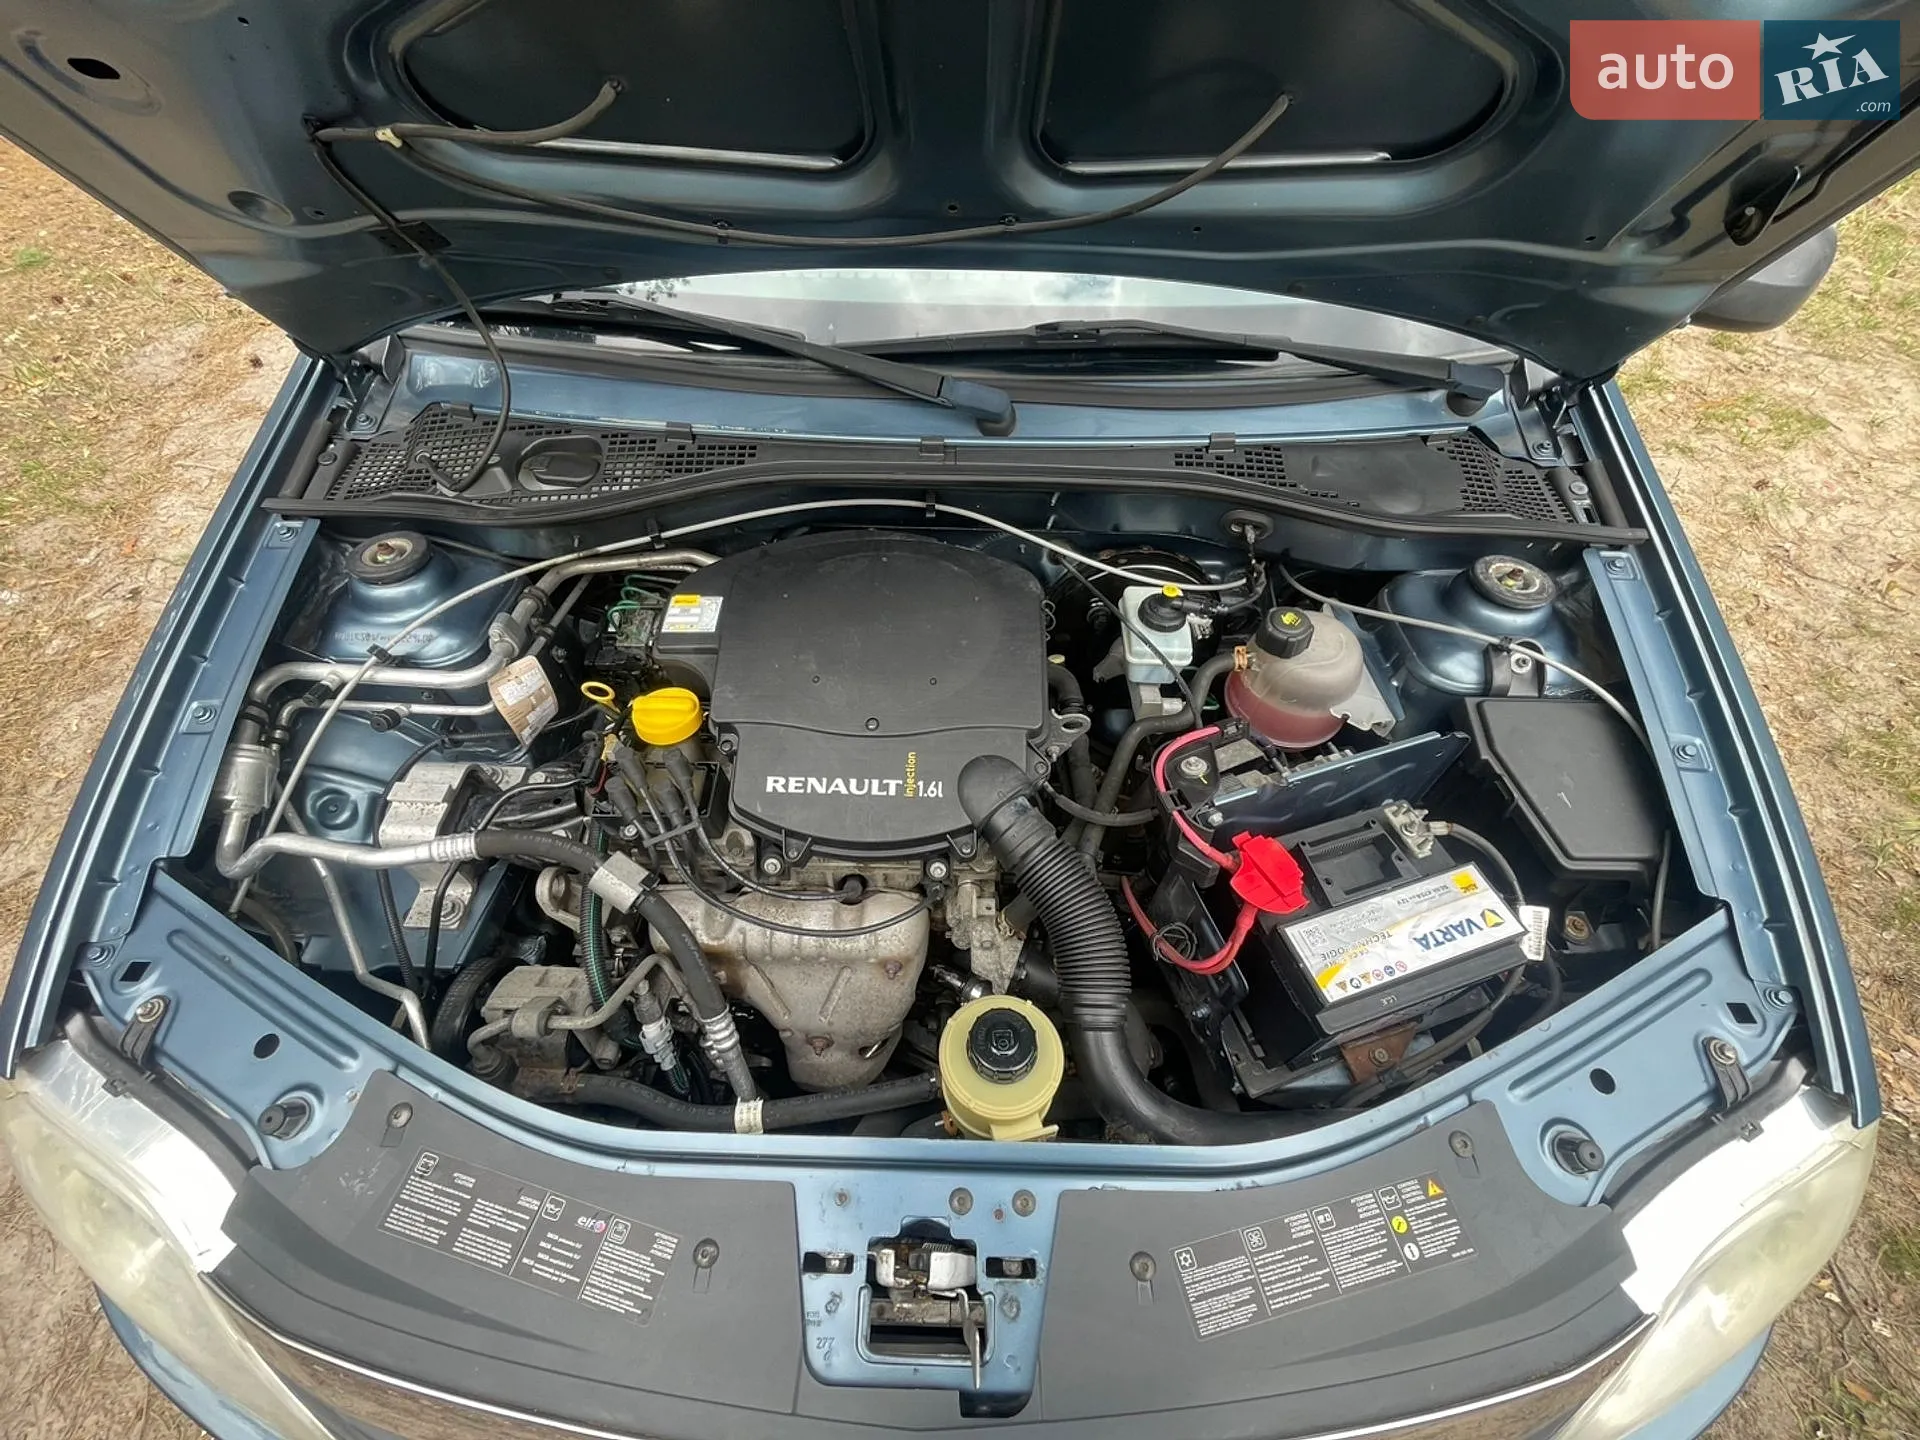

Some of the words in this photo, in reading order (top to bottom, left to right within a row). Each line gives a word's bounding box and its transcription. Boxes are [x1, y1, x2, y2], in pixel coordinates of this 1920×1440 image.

[765, 775, 903, 797] RENAULT
[1320, 929, 1393, 961] TECHNOGIE
[1412, 918, 1484, 951] VARTA
